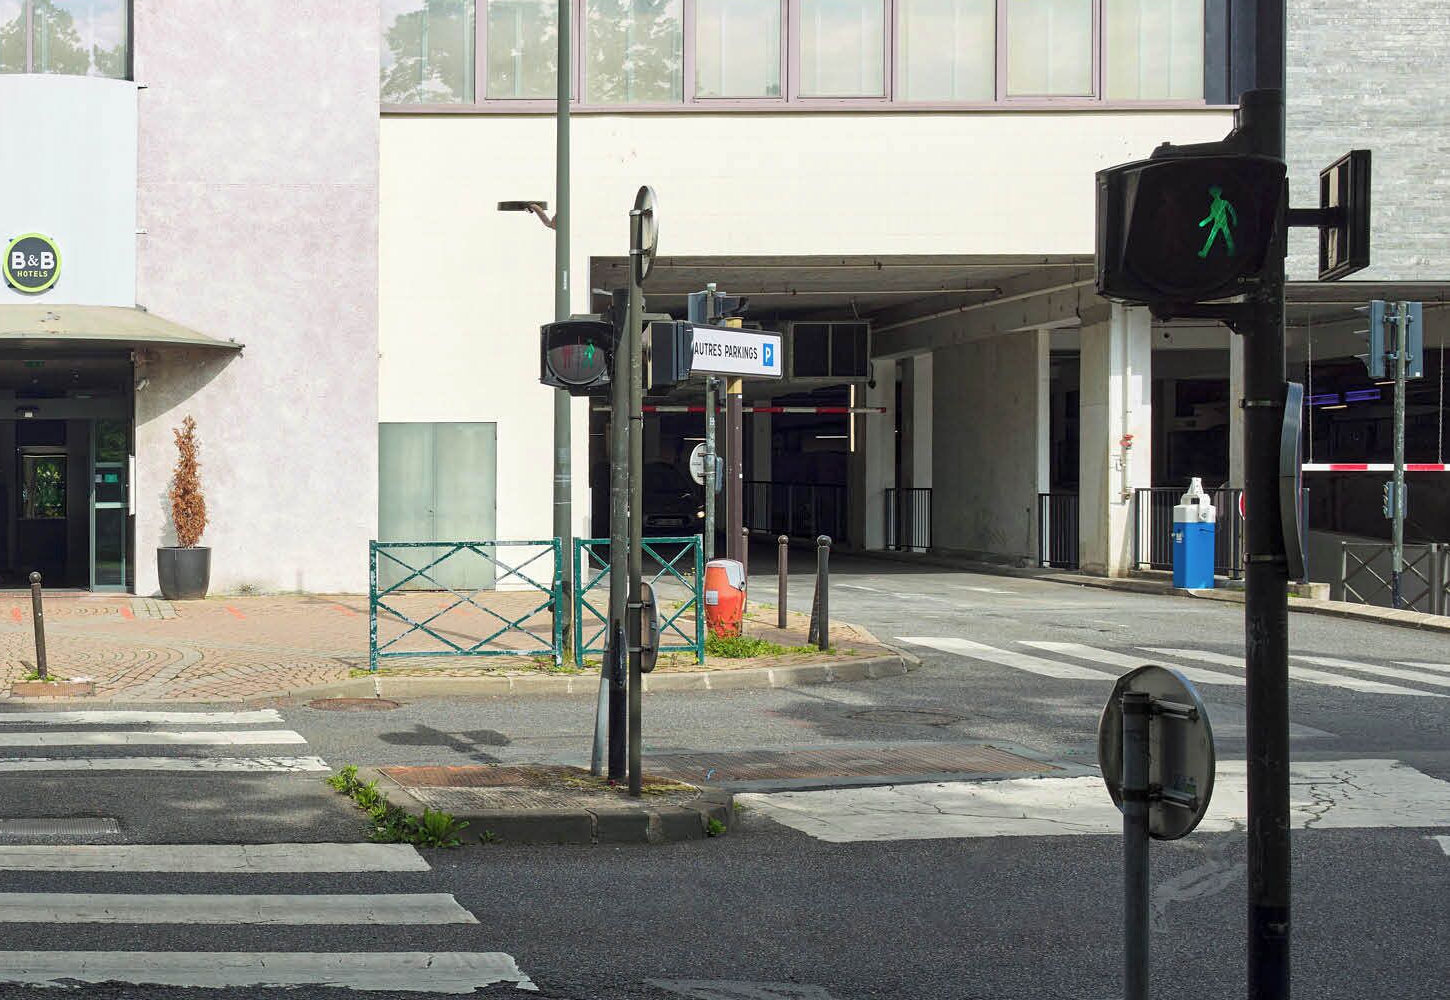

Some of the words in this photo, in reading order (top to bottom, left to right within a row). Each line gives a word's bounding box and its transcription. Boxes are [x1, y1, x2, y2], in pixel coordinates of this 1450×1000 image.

[12, 252, 55, 269] B&B
[694, 341, 722, 357] AUTRES
[724, 344, 758, 360] PARKINGS
